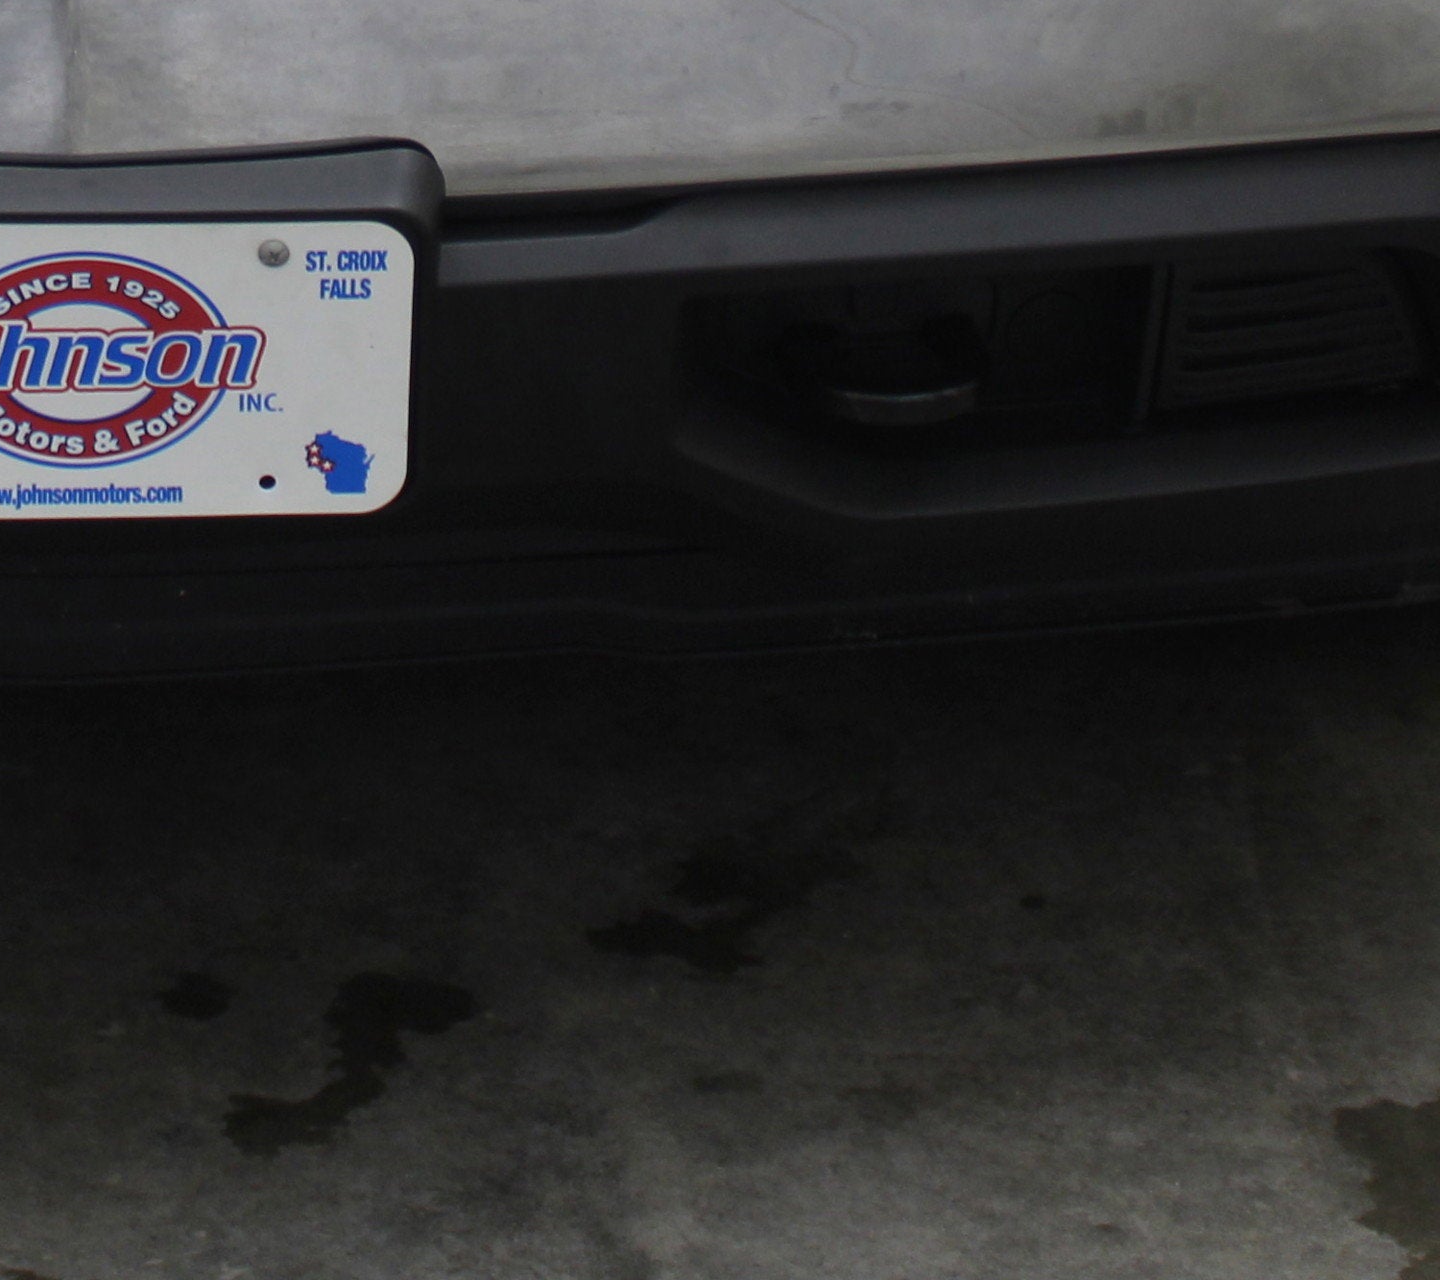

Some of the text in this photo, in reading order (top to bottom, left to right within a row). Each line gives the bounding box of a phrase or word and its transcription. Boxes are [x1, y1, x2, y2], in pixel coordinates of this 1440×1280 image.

[305, 250, 388, 272] ST. CROIX
[106, 275, 182, 320] 1925
[320, 278, 372, 300] FALLS
[239, 393, 284, 413] INC.
[93, 429, 120, 454] &
[124, 391, 197, 446] Ford
